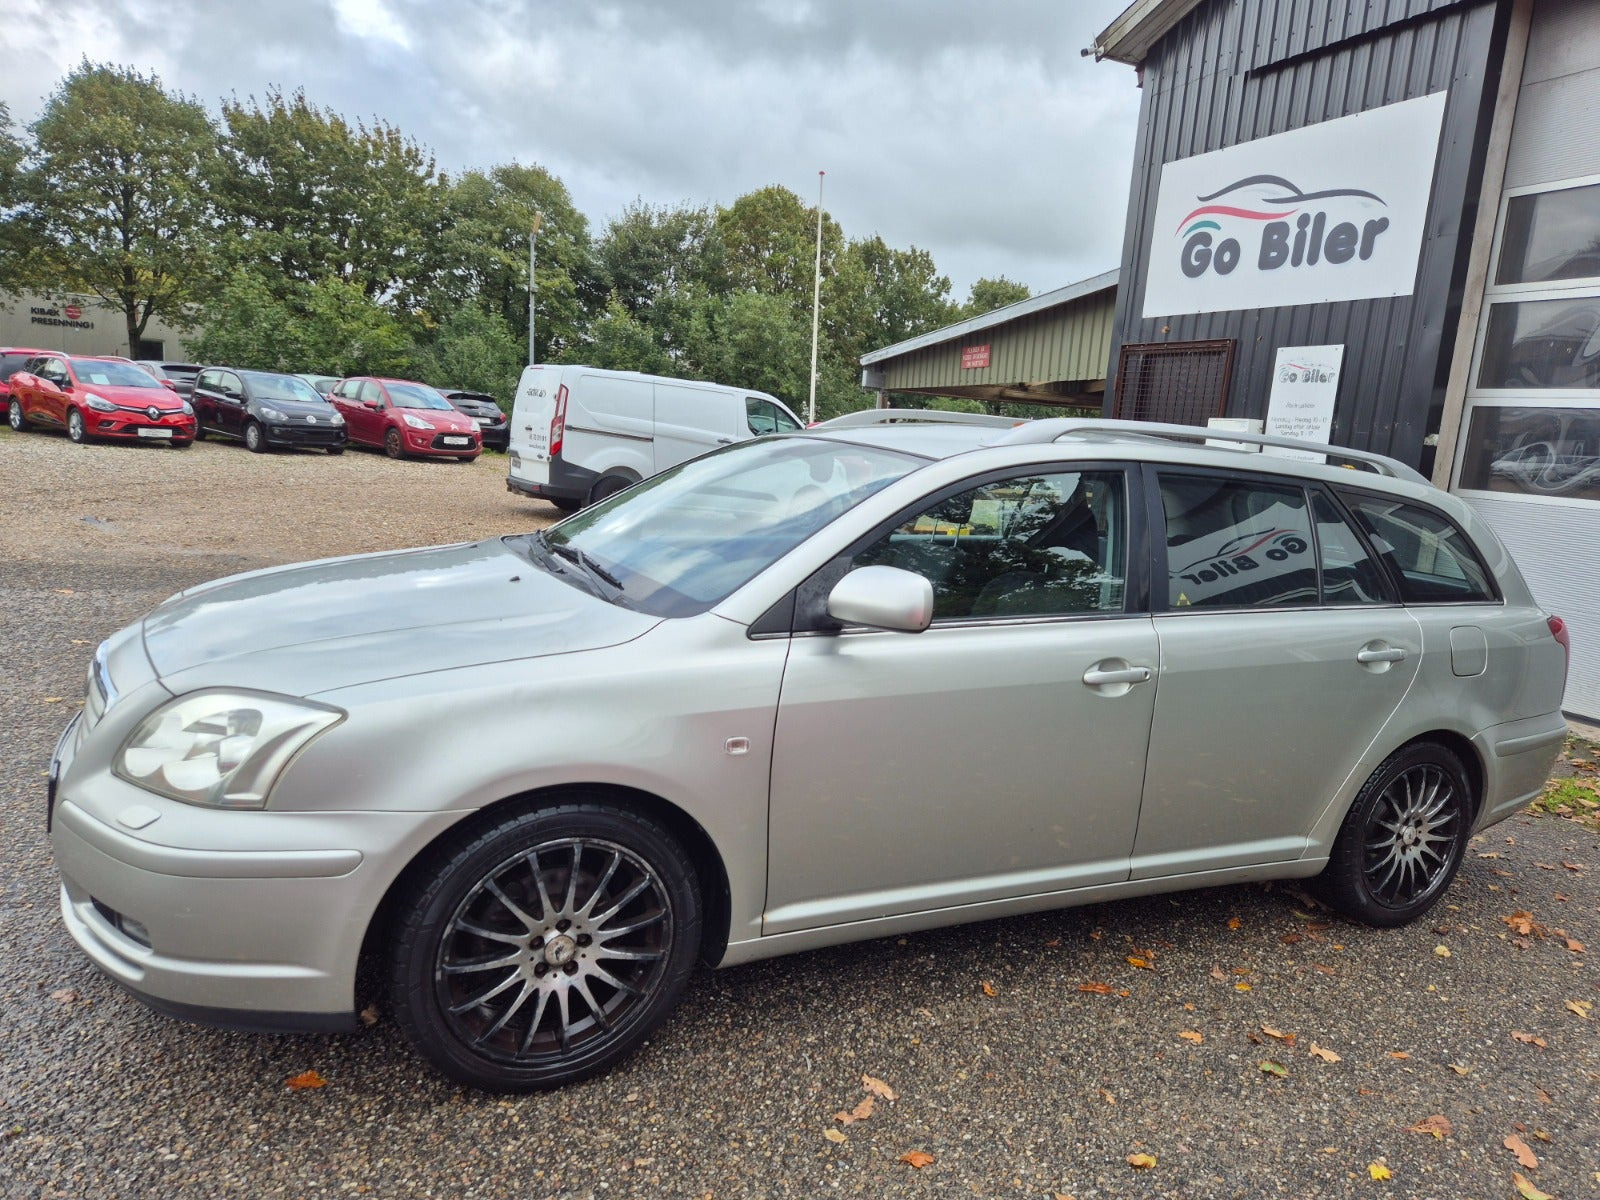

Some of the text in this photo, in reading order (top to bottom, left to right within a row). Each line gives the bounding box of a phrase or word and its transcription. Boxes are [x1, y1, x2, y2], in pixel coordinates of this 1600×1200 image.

[1181, 211, 1390, 278] Go Biler
[31, 307, 60, 316] KIBÆK
[1279, 368, 1336, 384] Go Biler
